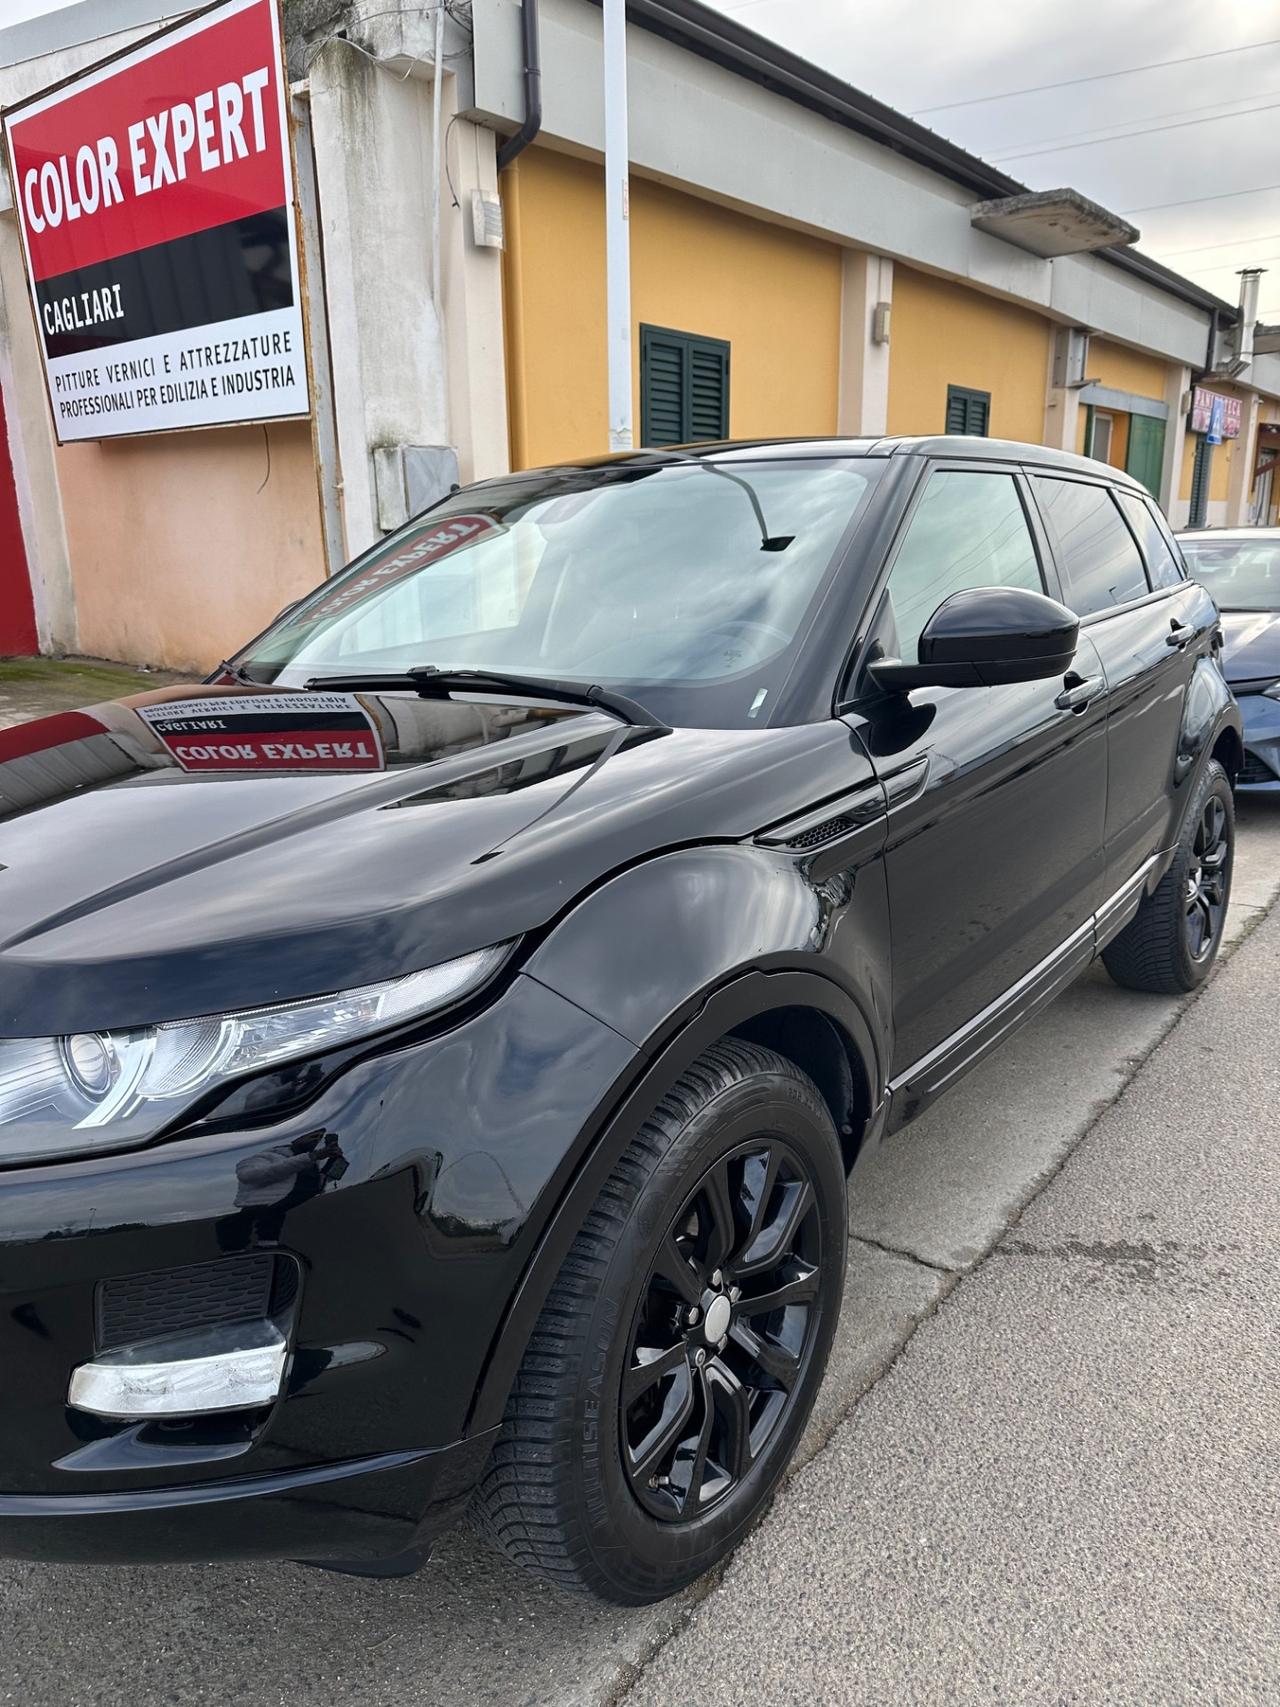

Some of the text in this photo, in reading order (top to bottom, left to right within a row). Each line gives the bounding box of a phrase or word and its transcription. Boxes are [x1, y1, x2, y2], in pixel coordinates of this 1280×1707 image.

[24, 66, 269, 234] COLOR EXPERT
[43, 283, 125, 336] CAGLIARI
[55, 331, 292, 393] PITTURE VERNICI E ATTREZZATURE
[60, 365, 296, 419] PROFESSIONALI PER EDILIZIA E INDUSTRIA
